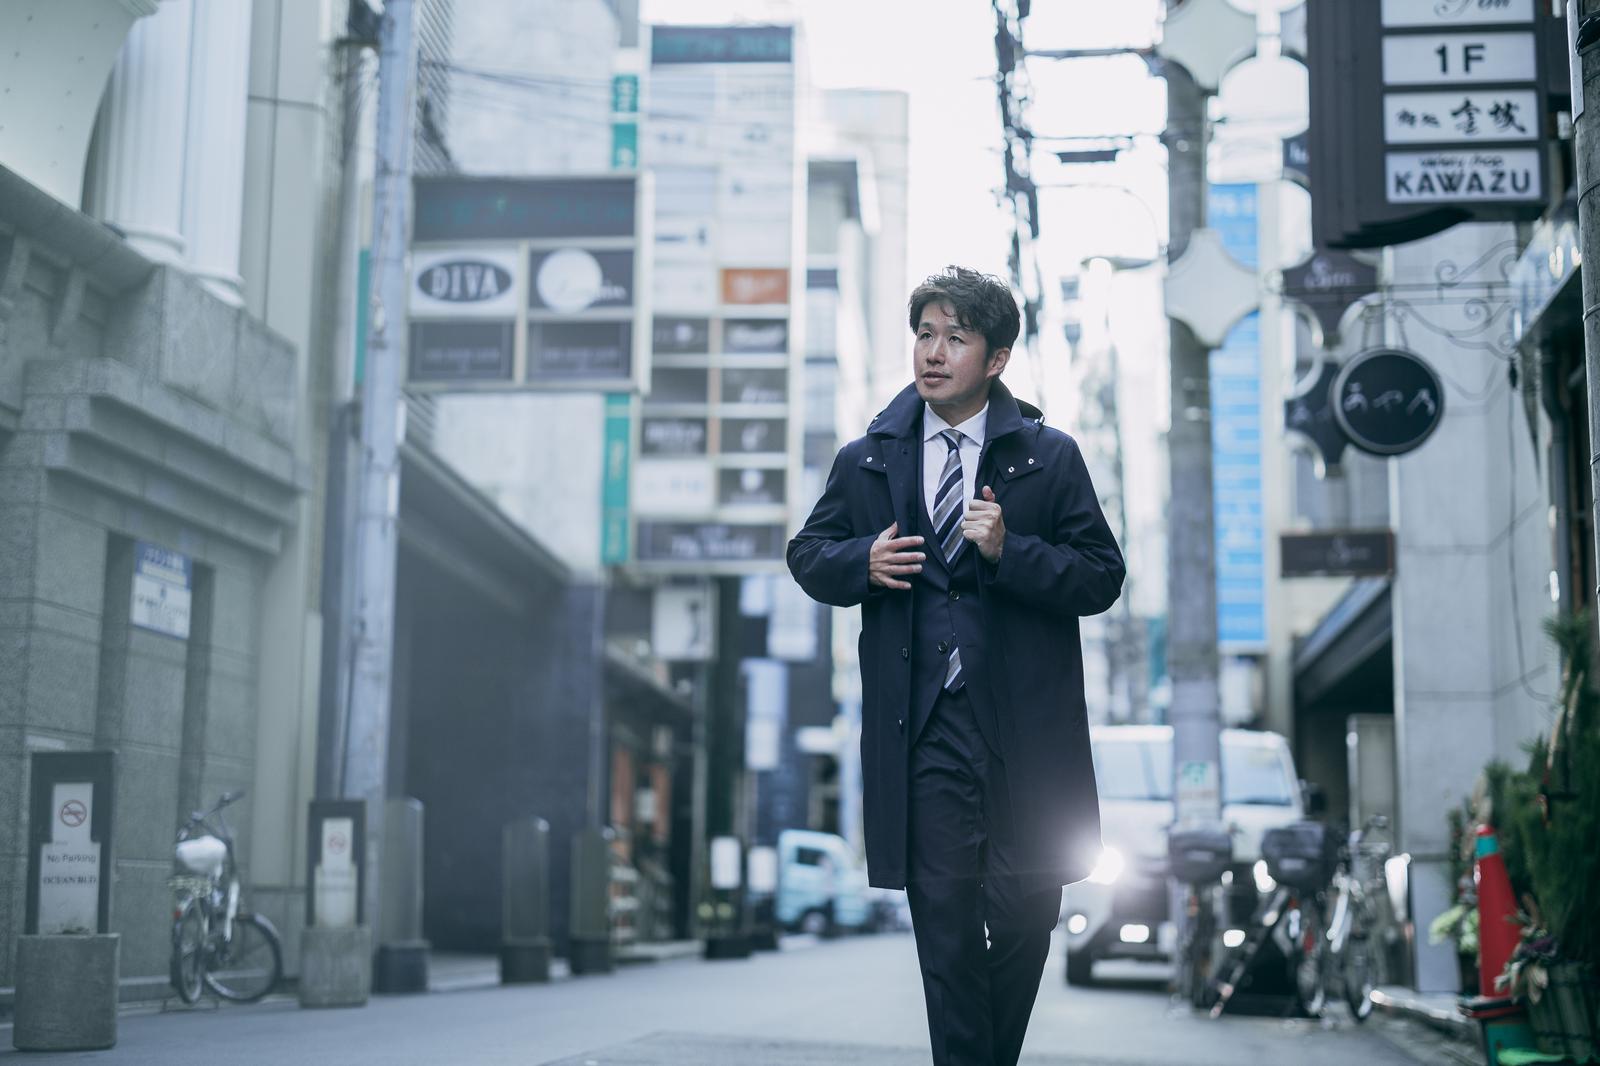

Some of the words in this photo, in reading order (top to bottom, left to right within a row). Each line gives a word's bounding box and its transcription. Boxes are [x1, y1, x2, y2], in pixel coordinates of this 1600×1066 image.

[1435, 43, 1486, 75] 1F
[1394, 169, 1530, 196] KAWAZU
[431, 265, 499, 300] DIVA
[47, 854, 59, 864] No
